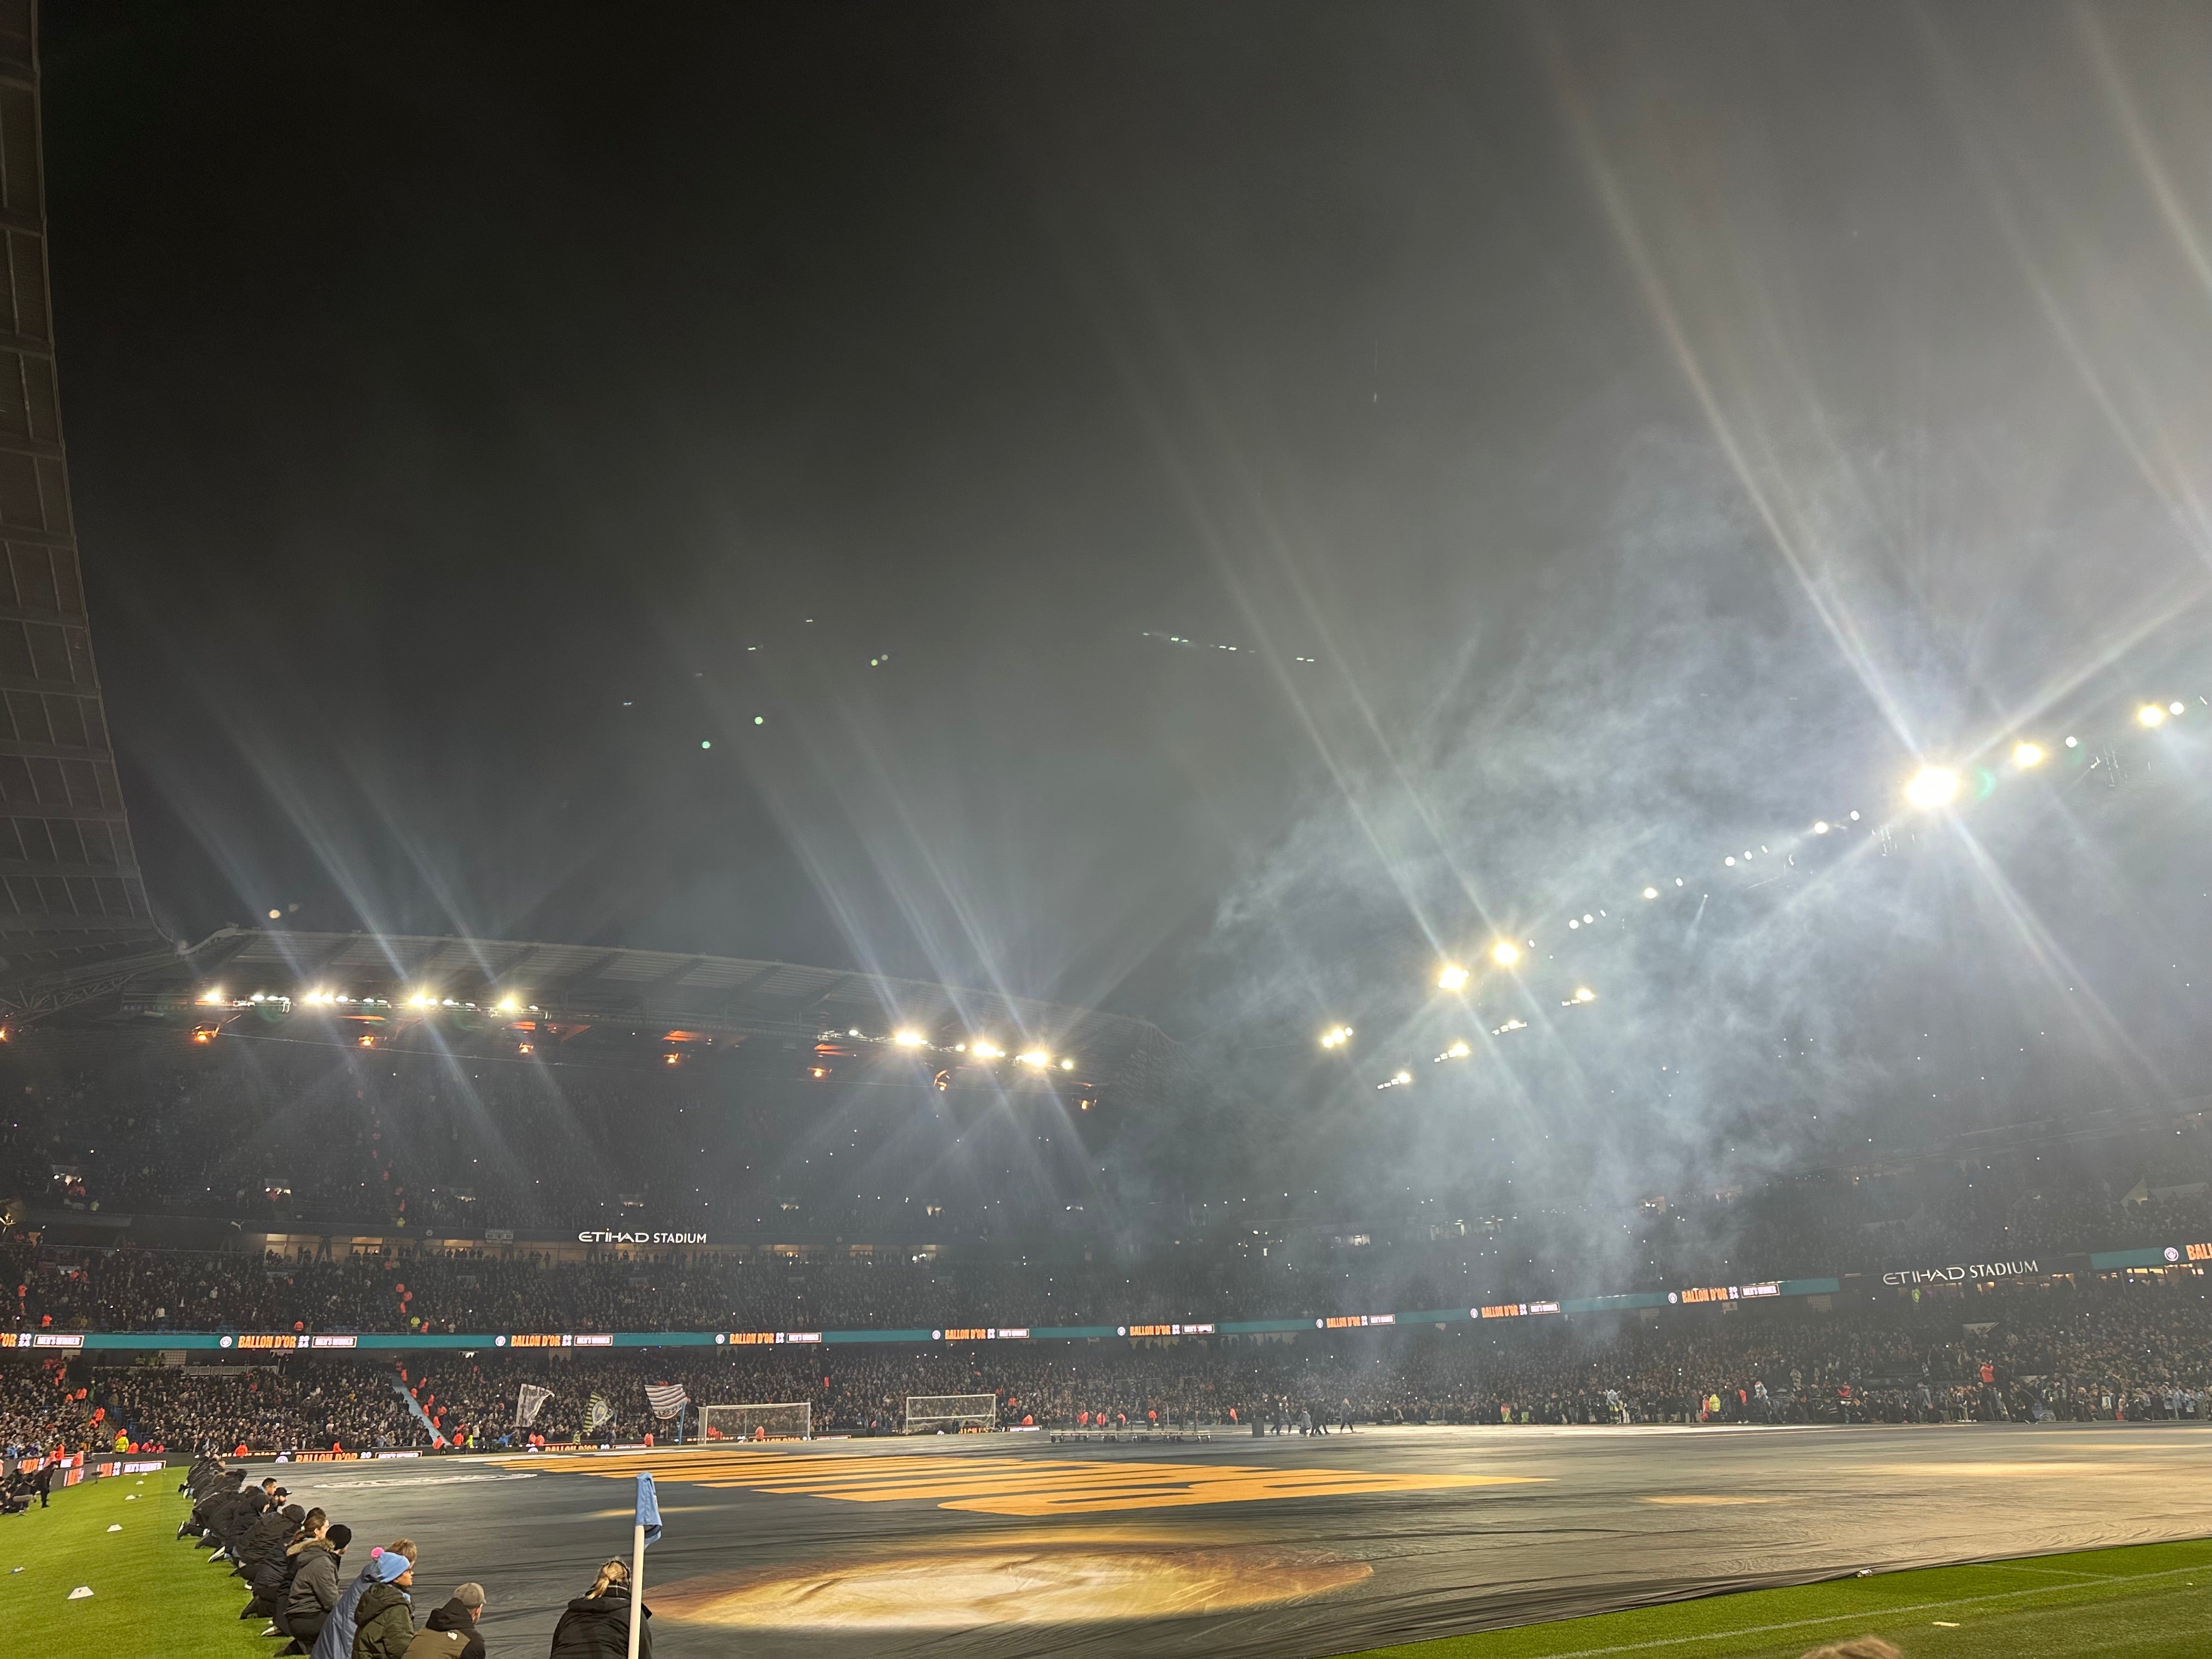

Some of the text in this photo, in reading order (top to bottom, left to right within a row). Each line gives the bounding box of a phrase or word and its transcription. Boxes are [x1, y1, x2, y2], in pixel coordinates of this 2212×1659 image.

[578, 1228, 707, 1244] ETIHAD STADIUM
[1882, 1260, 2039, 1285] ETIHAD STADIUM
[1681, 1289, 1709, 1303] BALLON
[945, 1329, 969, 1340] BALLON
[1130, 1325, 1154, 1336] BALLON
[238, 1335, 273, 1348] BALLON
[511, 1335, 540, 1347] BALLON
[730, 1333, 756, 1344] BALLON
